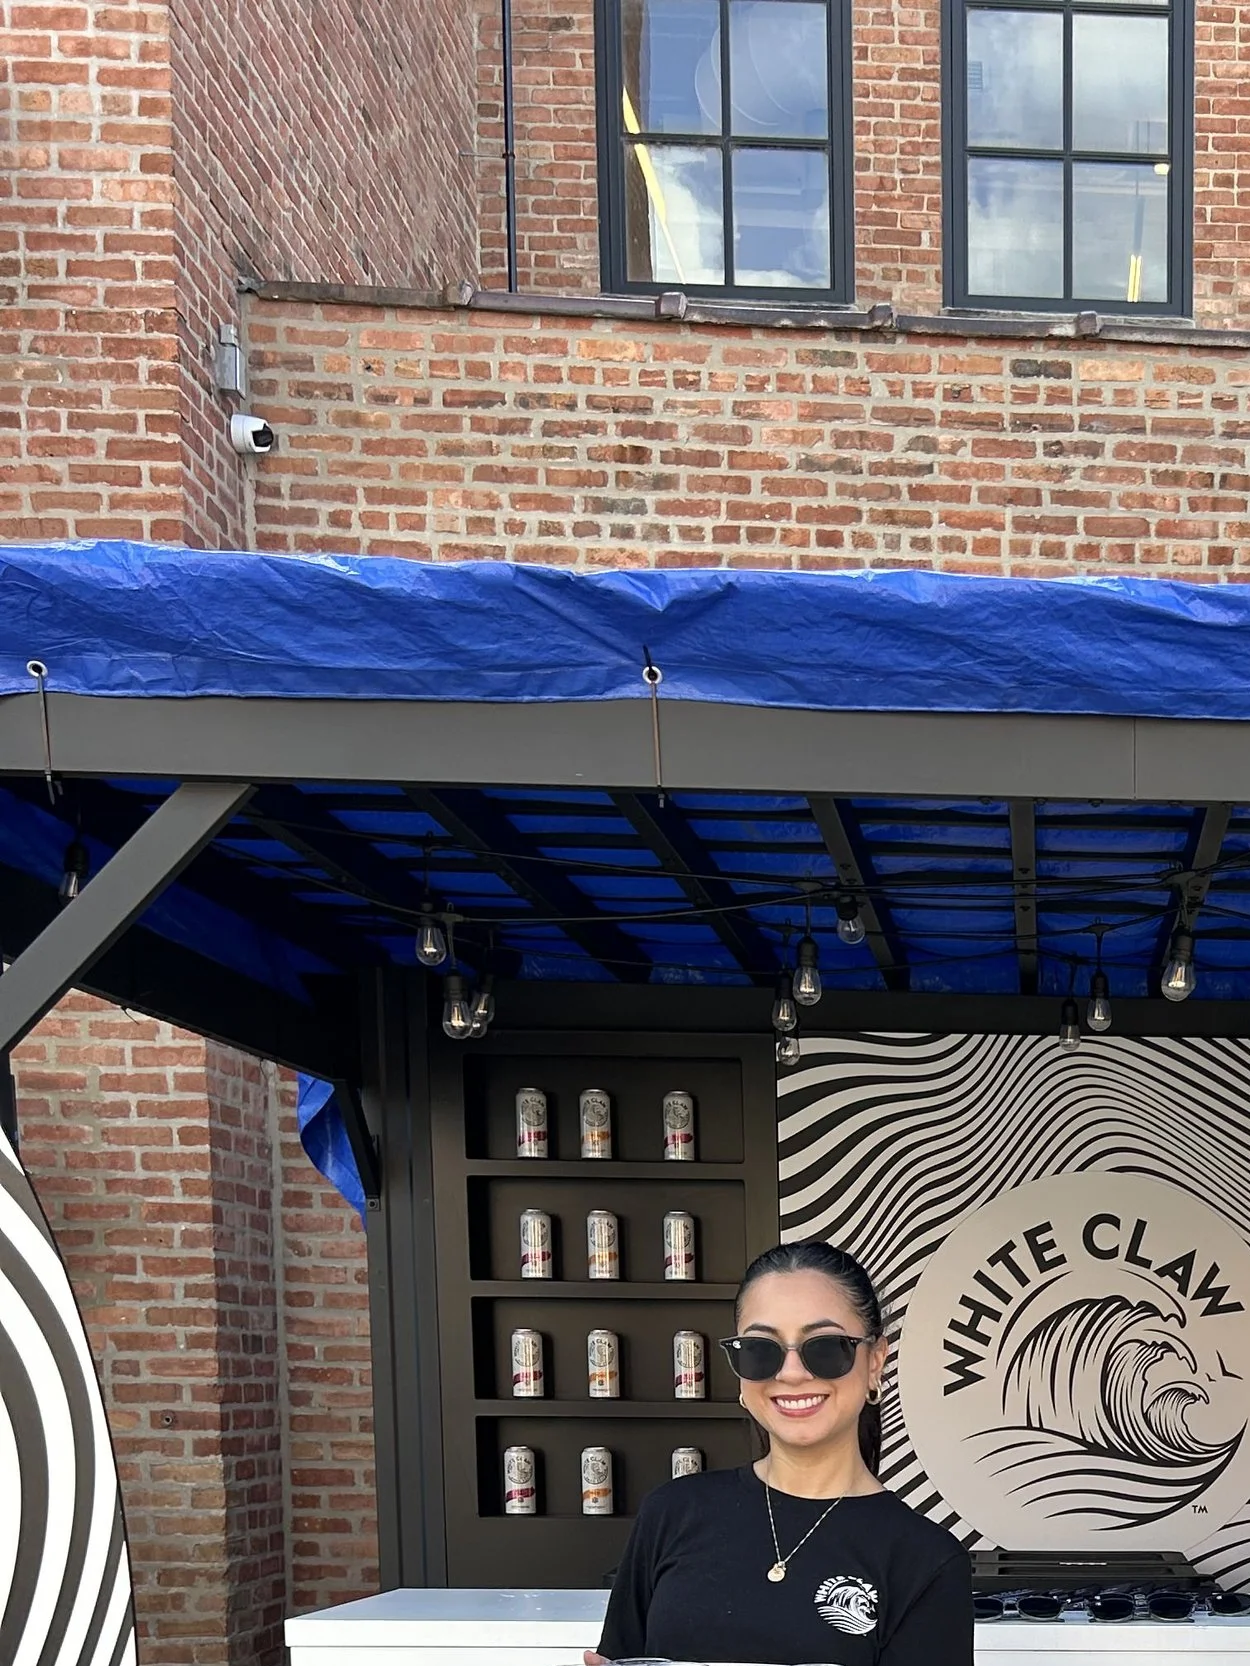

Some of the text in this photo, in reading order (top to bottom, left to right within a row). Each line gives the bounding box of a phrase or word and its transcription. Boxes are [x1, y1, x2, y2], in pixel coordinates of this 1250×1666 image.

[943, 1213, 1245, 1396] WHITE CLAW
[1191, 1504, 1208, 1514] TM
